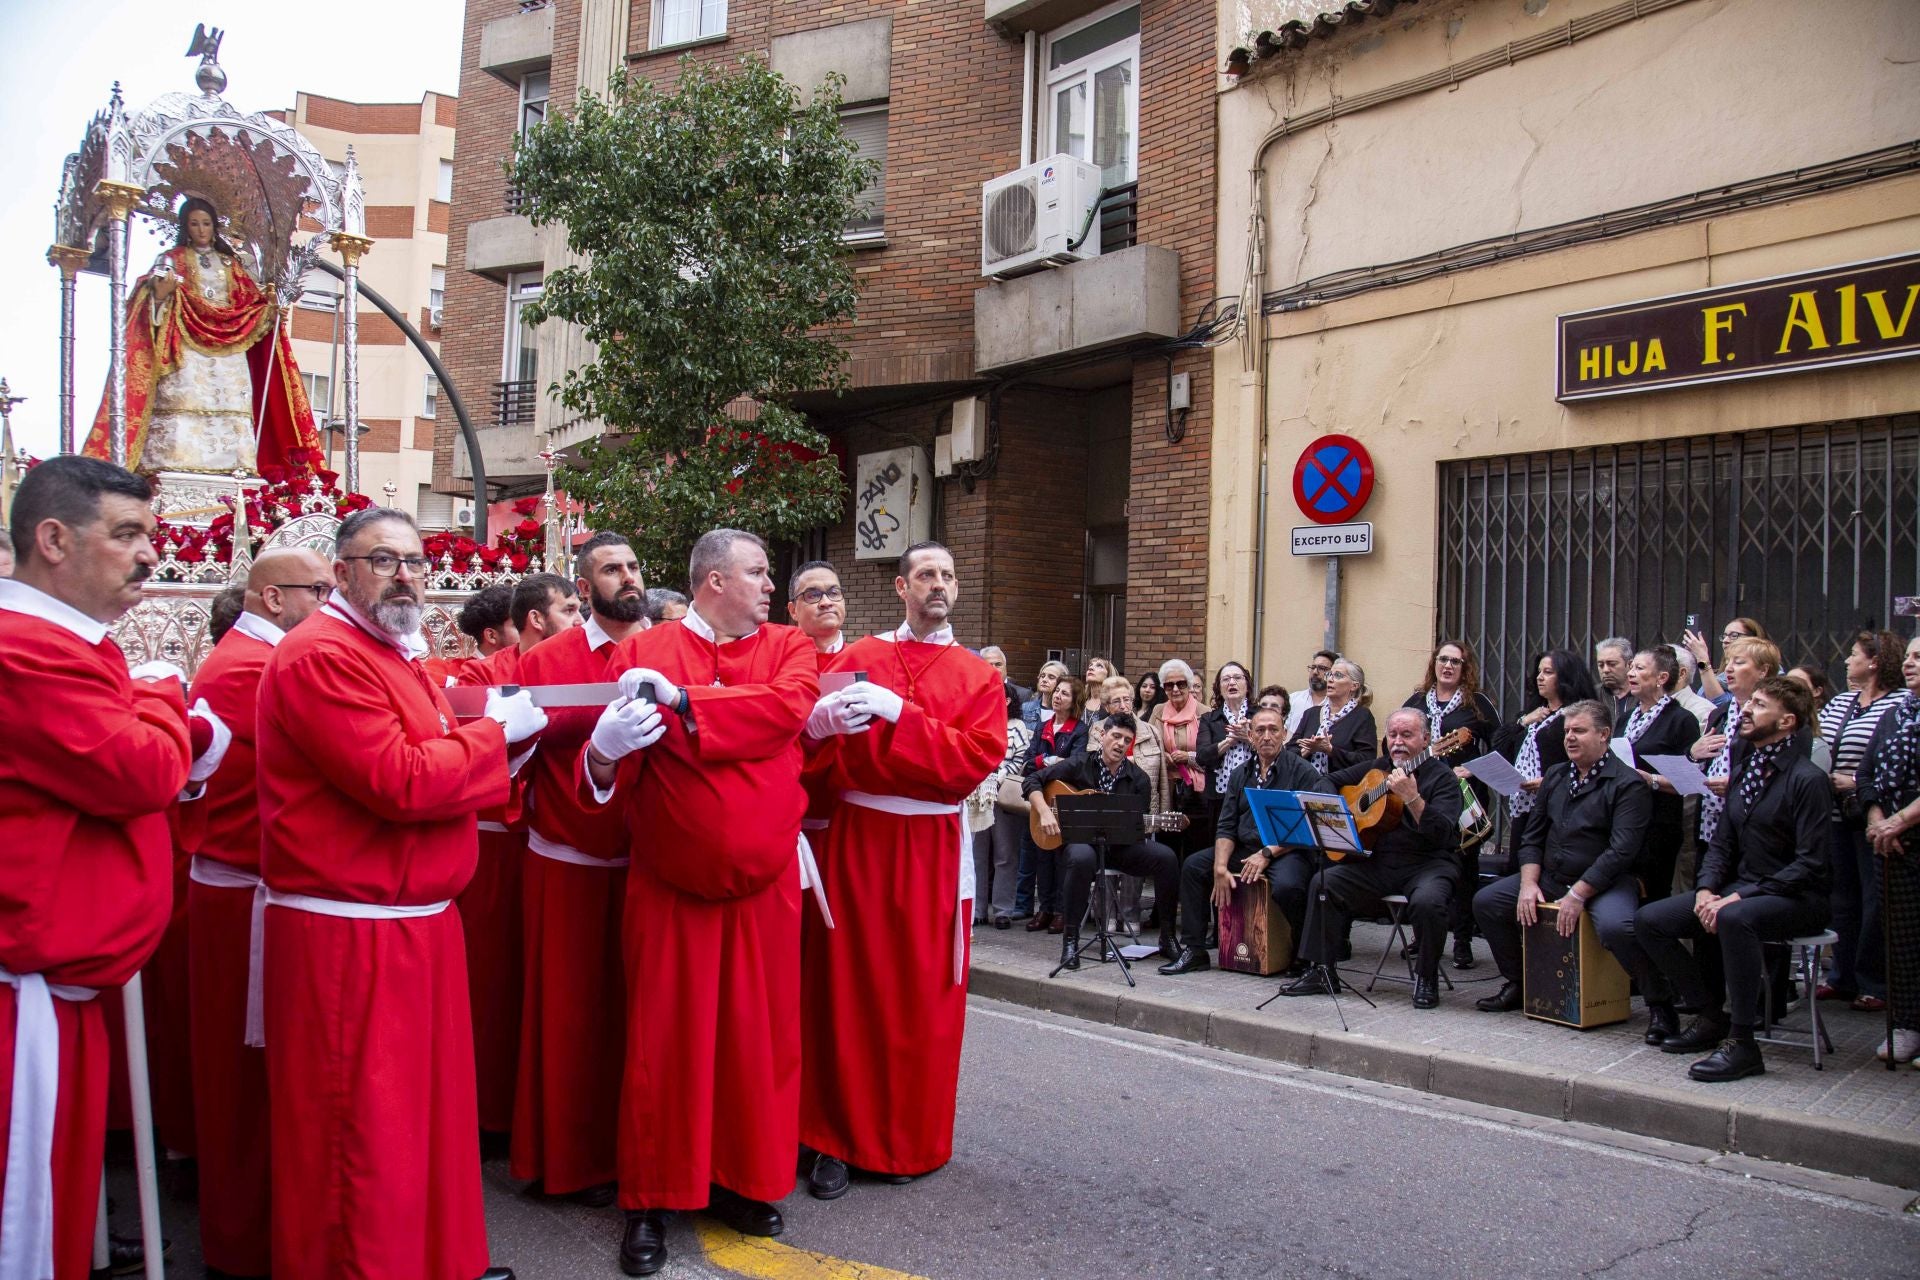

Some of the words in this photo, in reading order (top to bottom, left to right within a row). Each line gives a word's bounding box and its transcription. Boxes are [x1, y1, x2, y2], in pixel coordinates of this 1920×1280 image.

[1579, 338, 1667, 381] HIJA
[1701, 302, 1747, 365] F.
[1294, 535, 1342, 546] EXCEPTO
[1345, 534, 1367, 543] BUS
